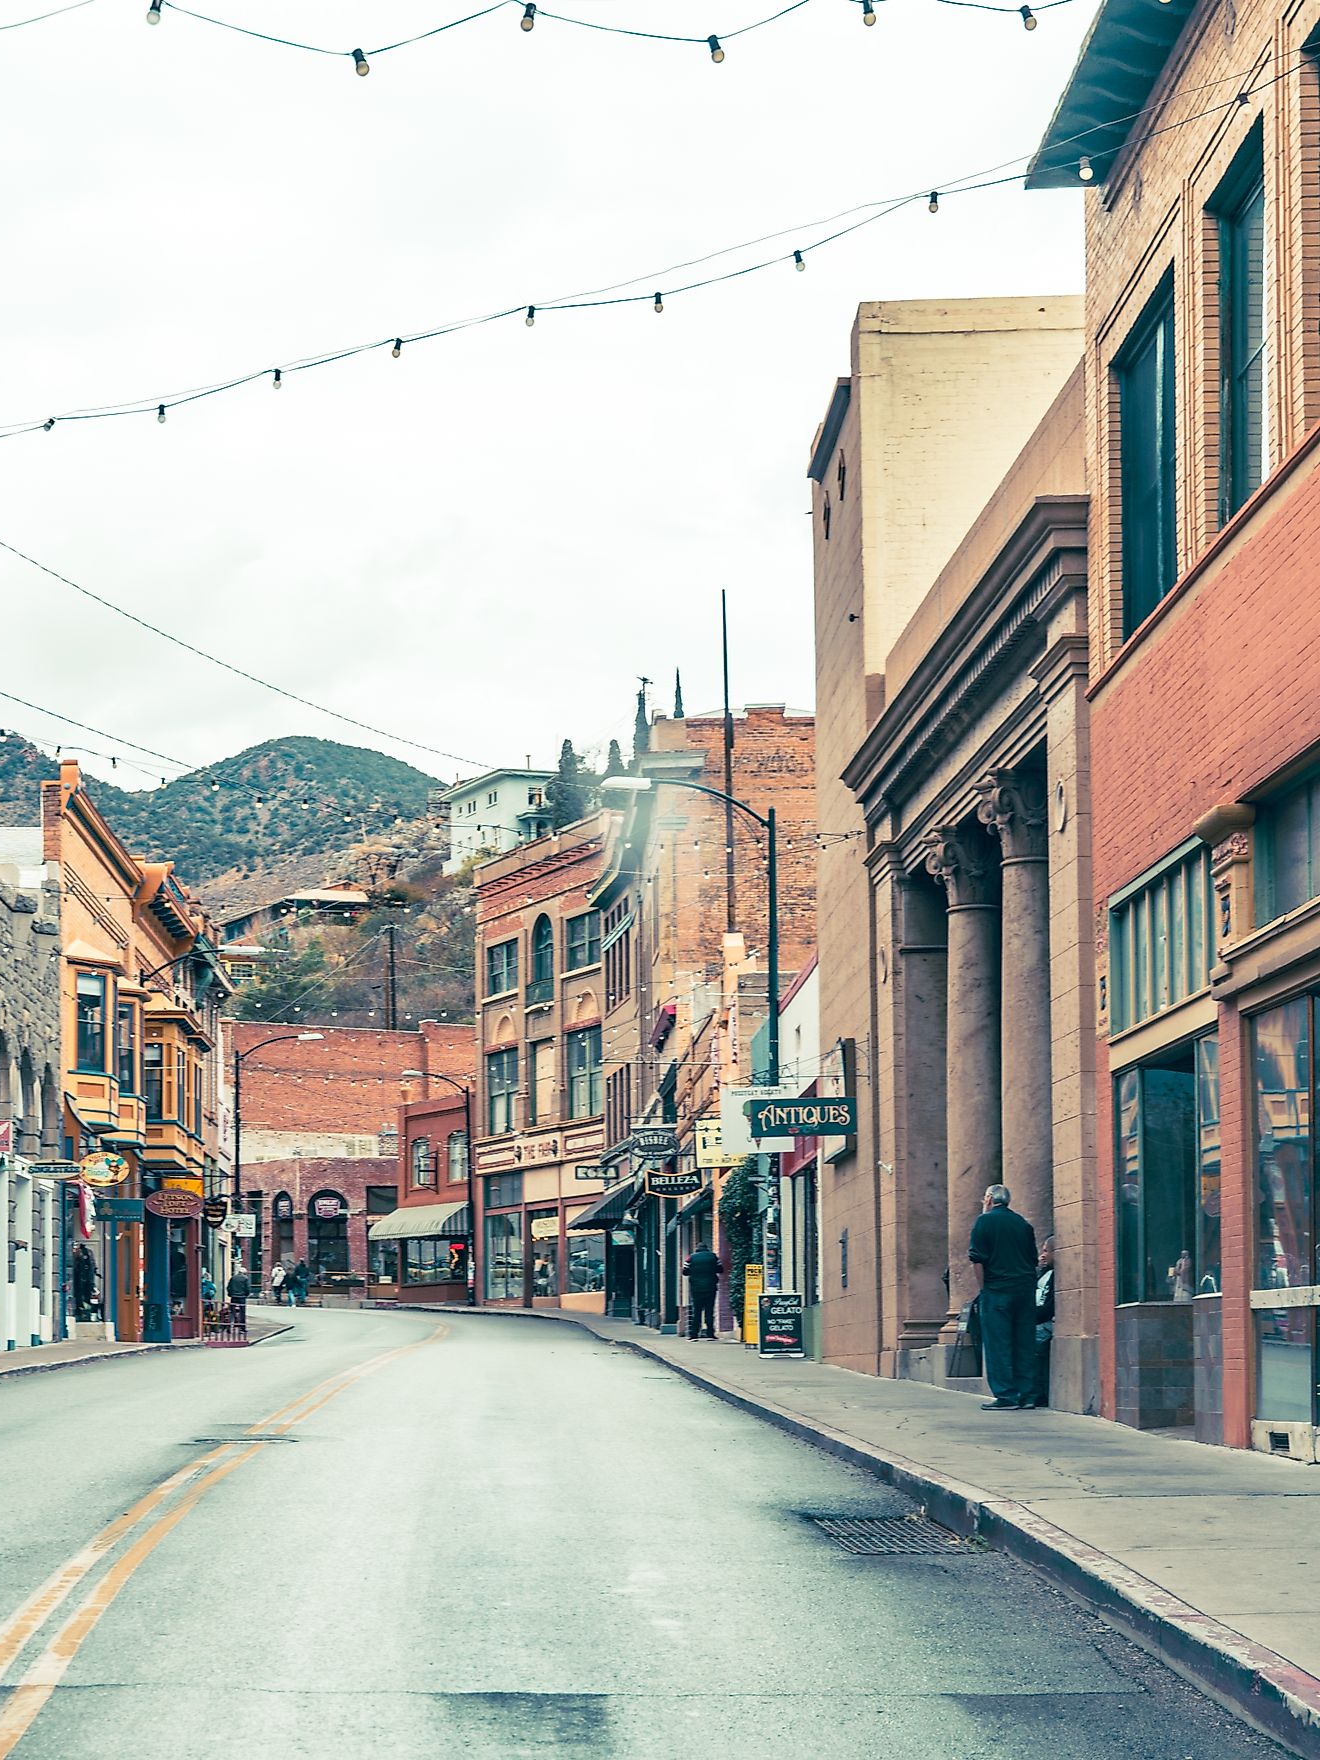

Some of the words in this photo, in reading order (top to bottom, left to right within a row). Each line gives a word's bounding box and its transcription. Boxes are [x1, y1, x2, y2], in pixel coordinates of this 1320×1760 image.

[757, 1104, 851, 1131] ANTIQUES
[650, 1175, 700, 1185] BELLEZA
[770, 1306, 803, 1315] GELATO
